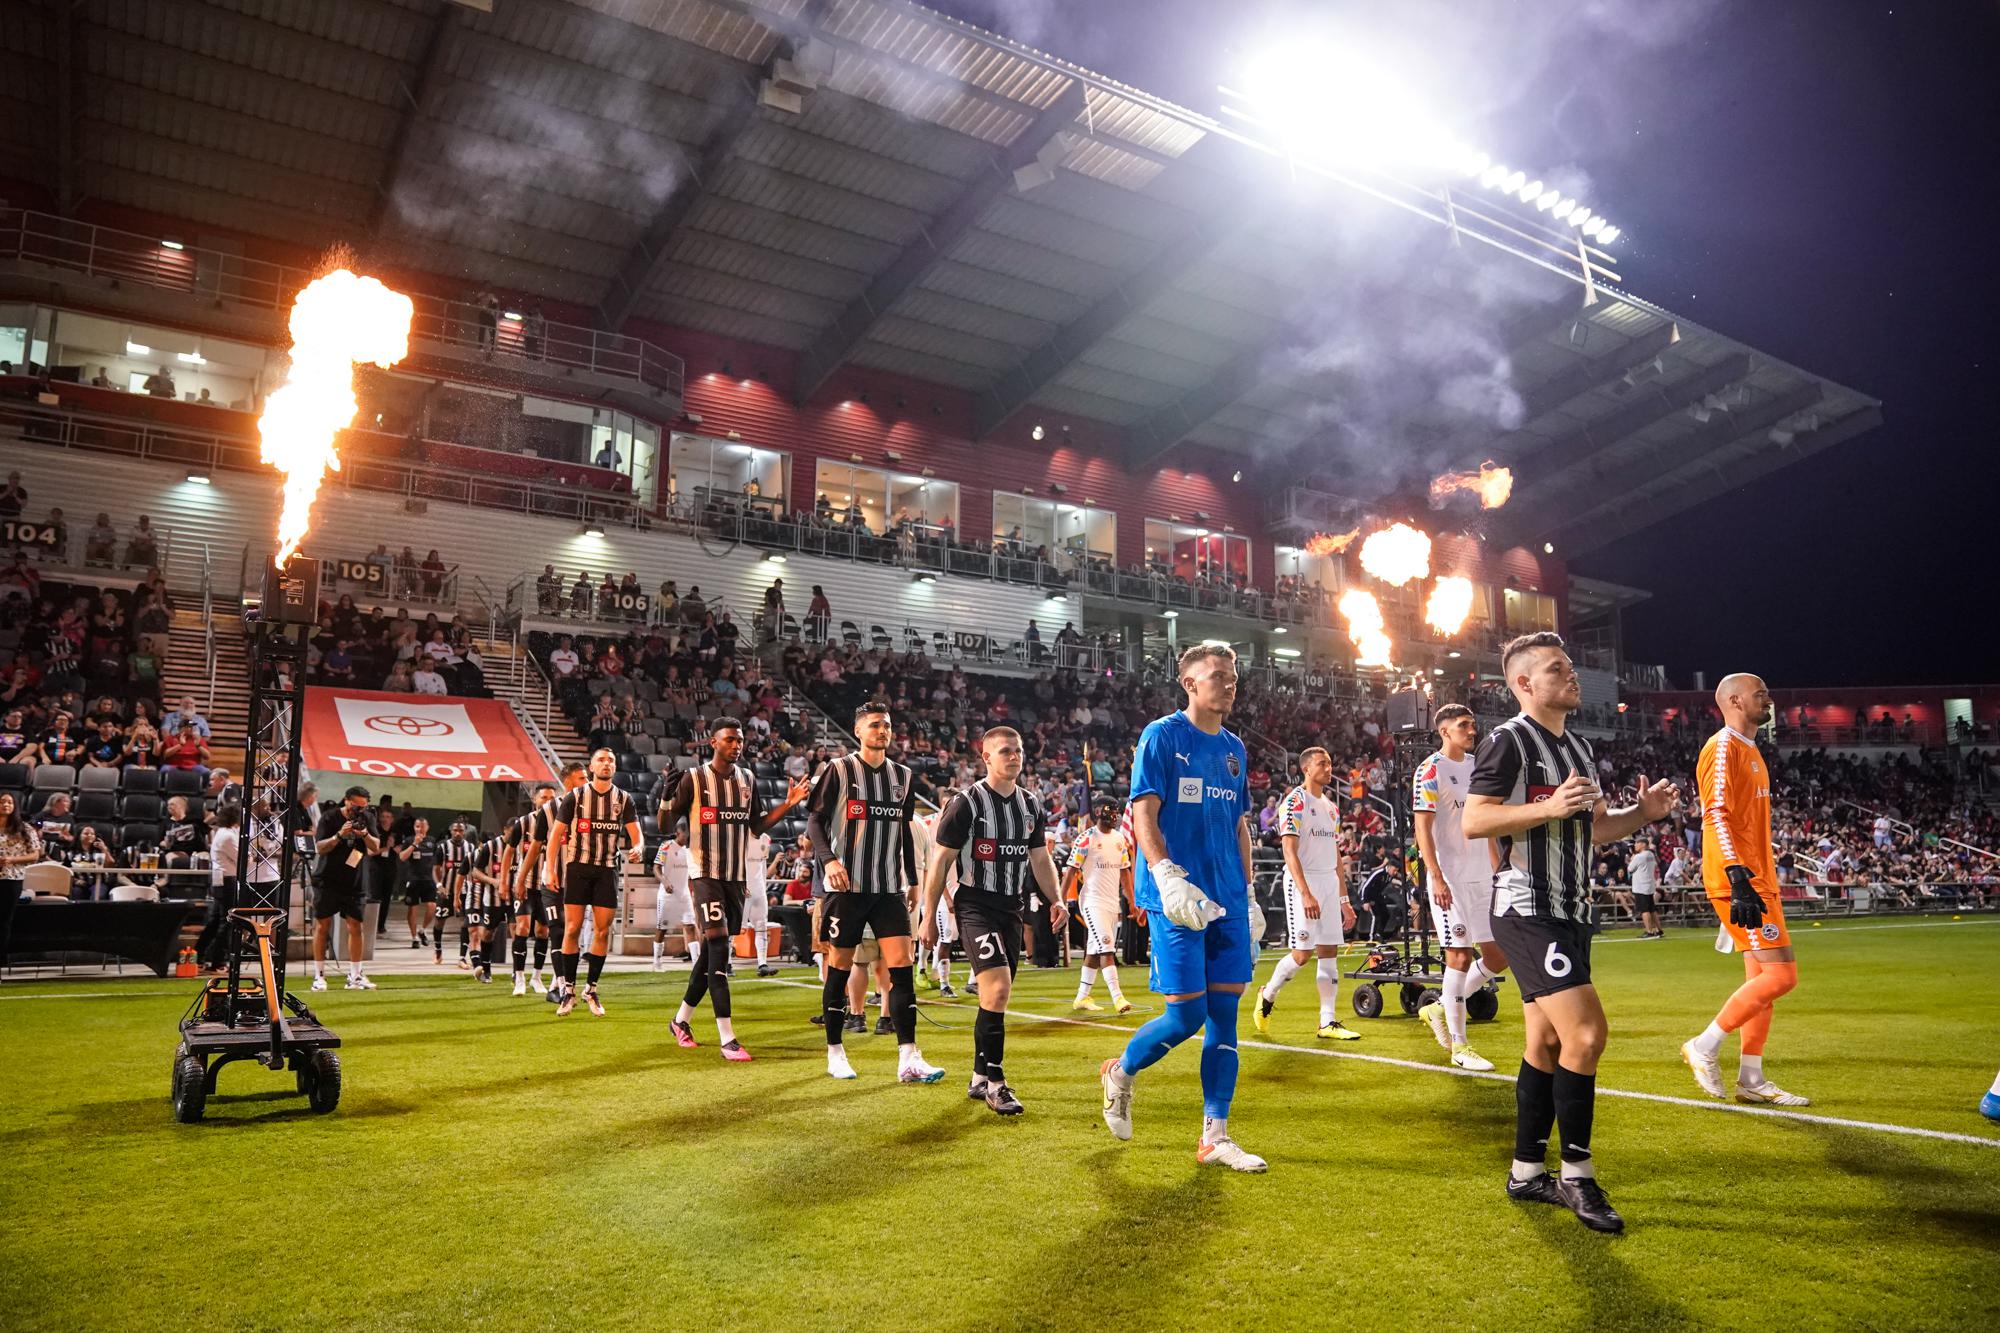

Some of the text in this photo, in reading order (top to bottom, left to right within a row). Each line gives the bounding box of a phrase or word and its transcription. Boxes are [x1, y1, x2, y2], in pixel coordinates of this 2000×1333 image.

[4, 522, 57, 545] 104
[341, 562, 381, 581] 105
[612, 593, 647, 611] 106
[957, 634, 983, 648] 107
[1305, 674, 1324, 687] 108
[328, 755, 524, 780] TOYOTA
[869, 806, 903, 818] TOYOTA
[591, 822, 620, 830] TOYOTA
[435, 906, 449, 918] 22
[513, 900, 521, 914] 9
[545, 905, 558, 921] 11
[700, 901, 722, 922] 15
[467, 913, 480, 924] 10
[828, 915, 841, 939] 3
[974, 932, 1005, 960] 31
[1544, 941, 1572, 978] 6
